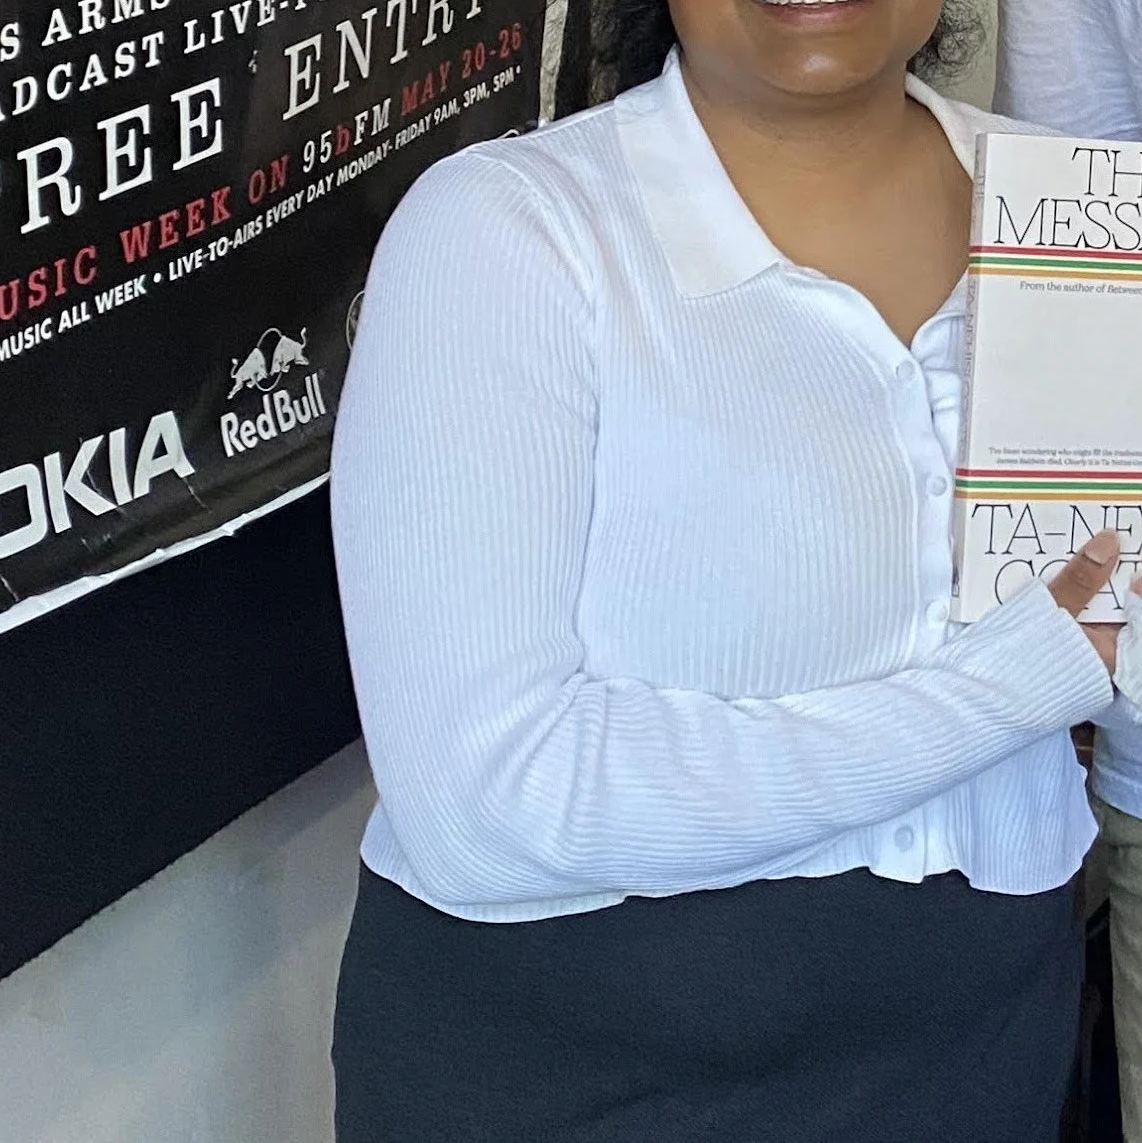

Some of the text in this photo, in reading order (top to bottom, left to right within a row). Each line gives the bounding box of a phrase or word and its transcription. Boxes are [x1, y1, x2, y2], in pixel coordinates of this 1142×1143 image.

[0, 22, 20, 62] S
[0, 31, 164, 122] DCAST
[17, 78, 223, 235] REE
[120, 186, 231, 264] WEEK
[249, 154, 290, 203] ON
[303, 98, 391, 173] 95bFM
[401, 61, 450, 115] MAY
[461, 23, 522, 79] 20-26
[0, 318, 51, 361] MUSIC
[58, 301, 91, 333] ALL
[95, 274, 147, 314] WEEK
[169, 215, 263, 282] LIVE-TO-AIRS
[266, 190, 304, 229] EVERY
[307, 173, 334, 203] DAY
[395, 117, 432, 151] FRIDAY
[1020, 281, 1045, 291] From
[1047, 281, 1061, 292] the
[1063, 283, 1094, 293] author
[1096, 284, 1106, 293] of
